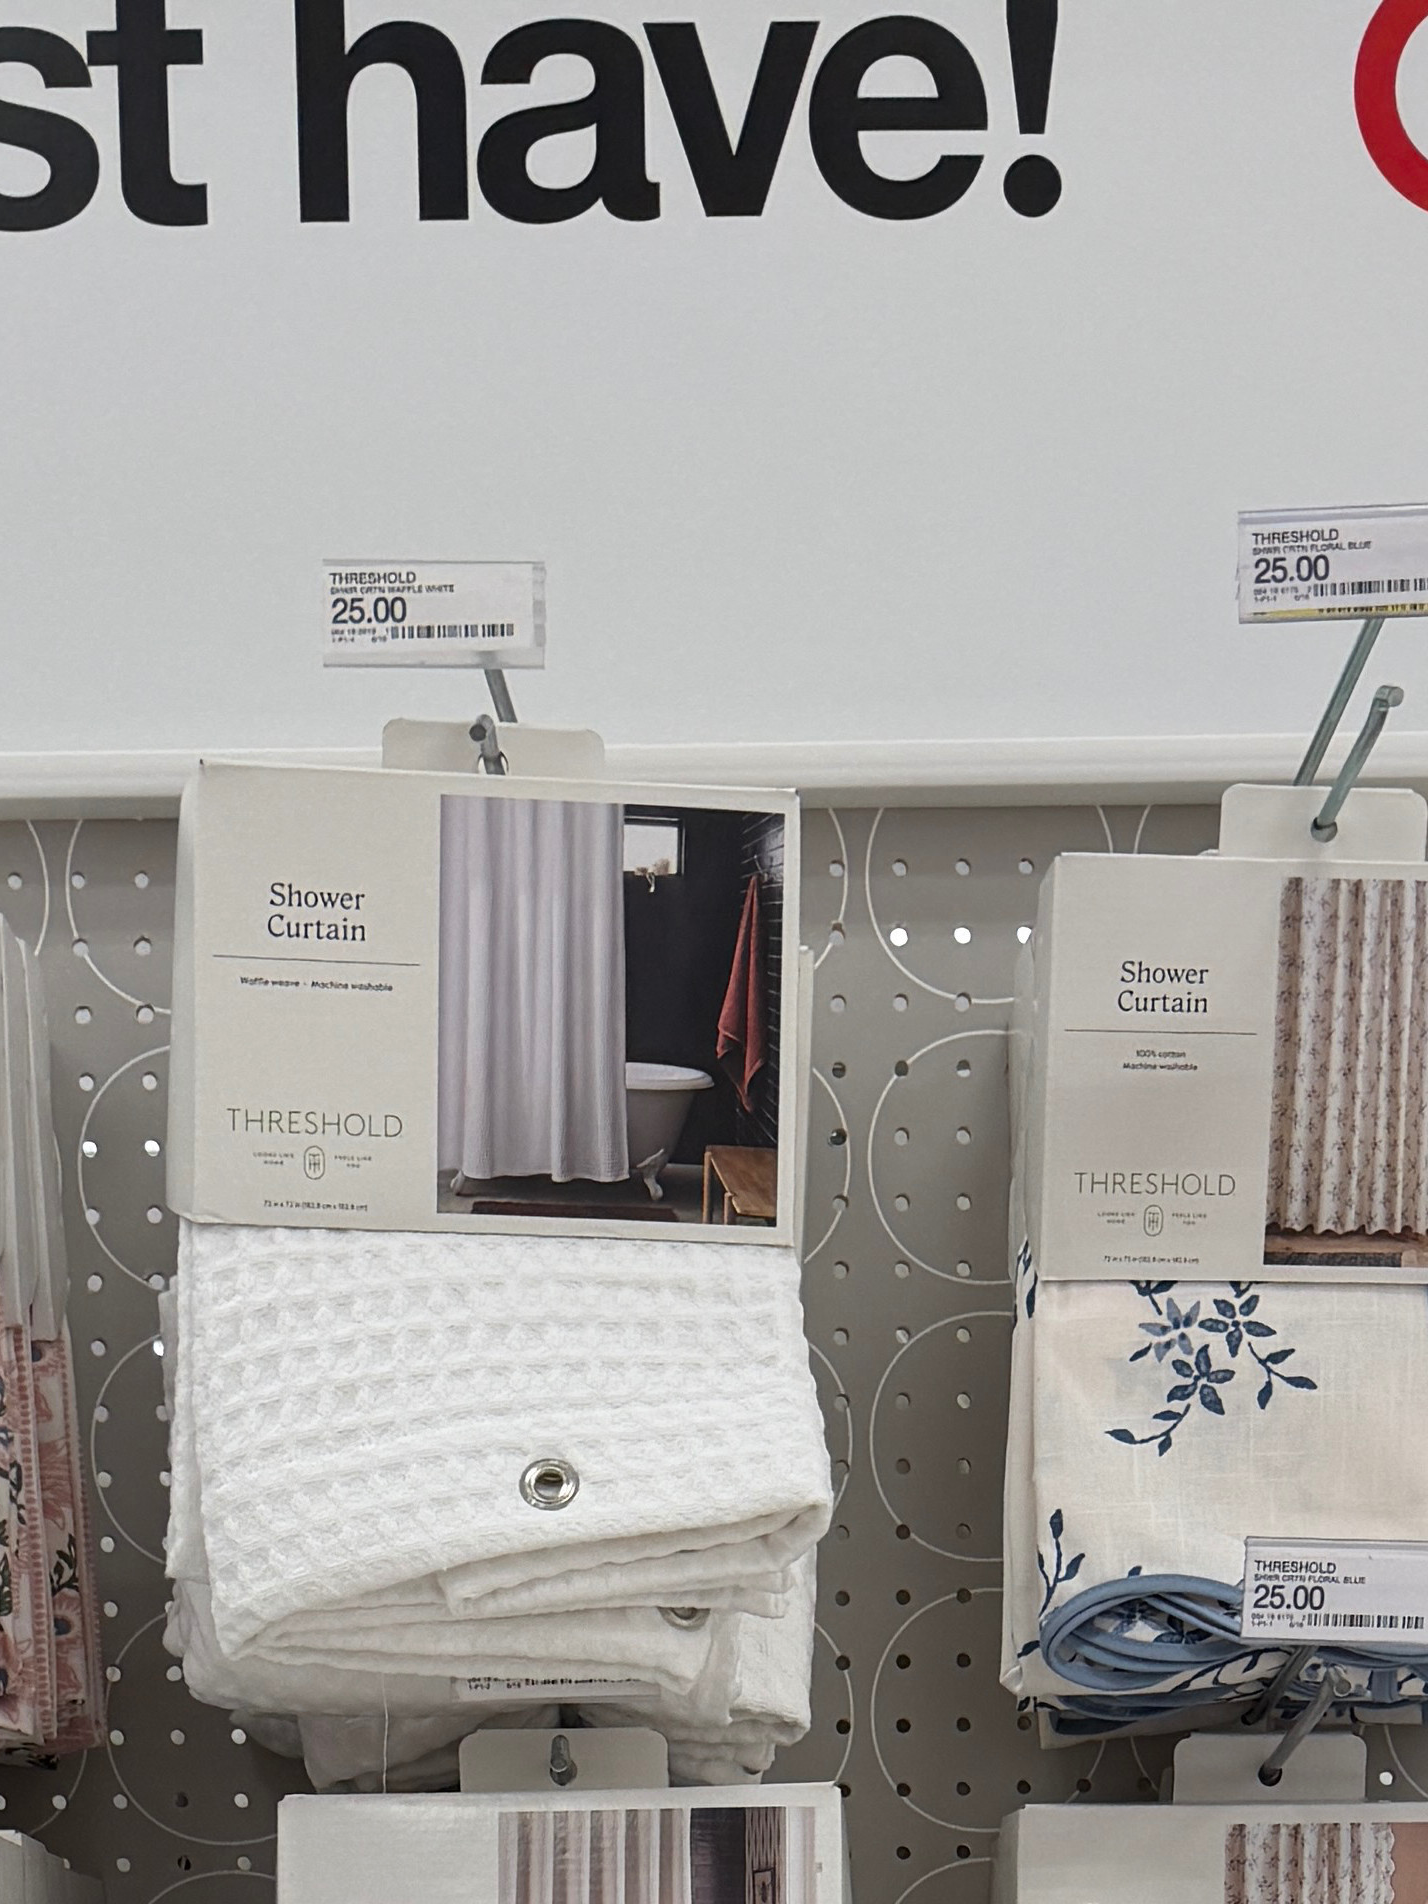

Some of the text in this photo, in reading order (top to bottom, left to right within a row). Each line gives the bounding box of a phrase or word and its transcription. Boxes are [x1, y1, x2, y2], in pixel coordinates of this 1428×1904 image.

[296, 0, 1063, 221] have!
[1252, 529, 1339, 545] THRESHOLD
[329, 571, 416, 585] THRESHOLD
[1254, 555, 1329, 584] 25.00
[332, 596, 407, 624] 25.00
[270, 882, 365, 910] Shower
[268, 914, 365, 941] Curtain
[1120, 961, 1209, 984] Shower
[1118, 990, 1208, 1013] Curtain
[227, 1108, 403, 1137] THRESHOLD
[1074, 1172, 1236, 1196] THRESHOLD
[1254, 1560, 1336, 1574] THRESHOLD
[1253, 1584, 1325, 1610] 25.00
